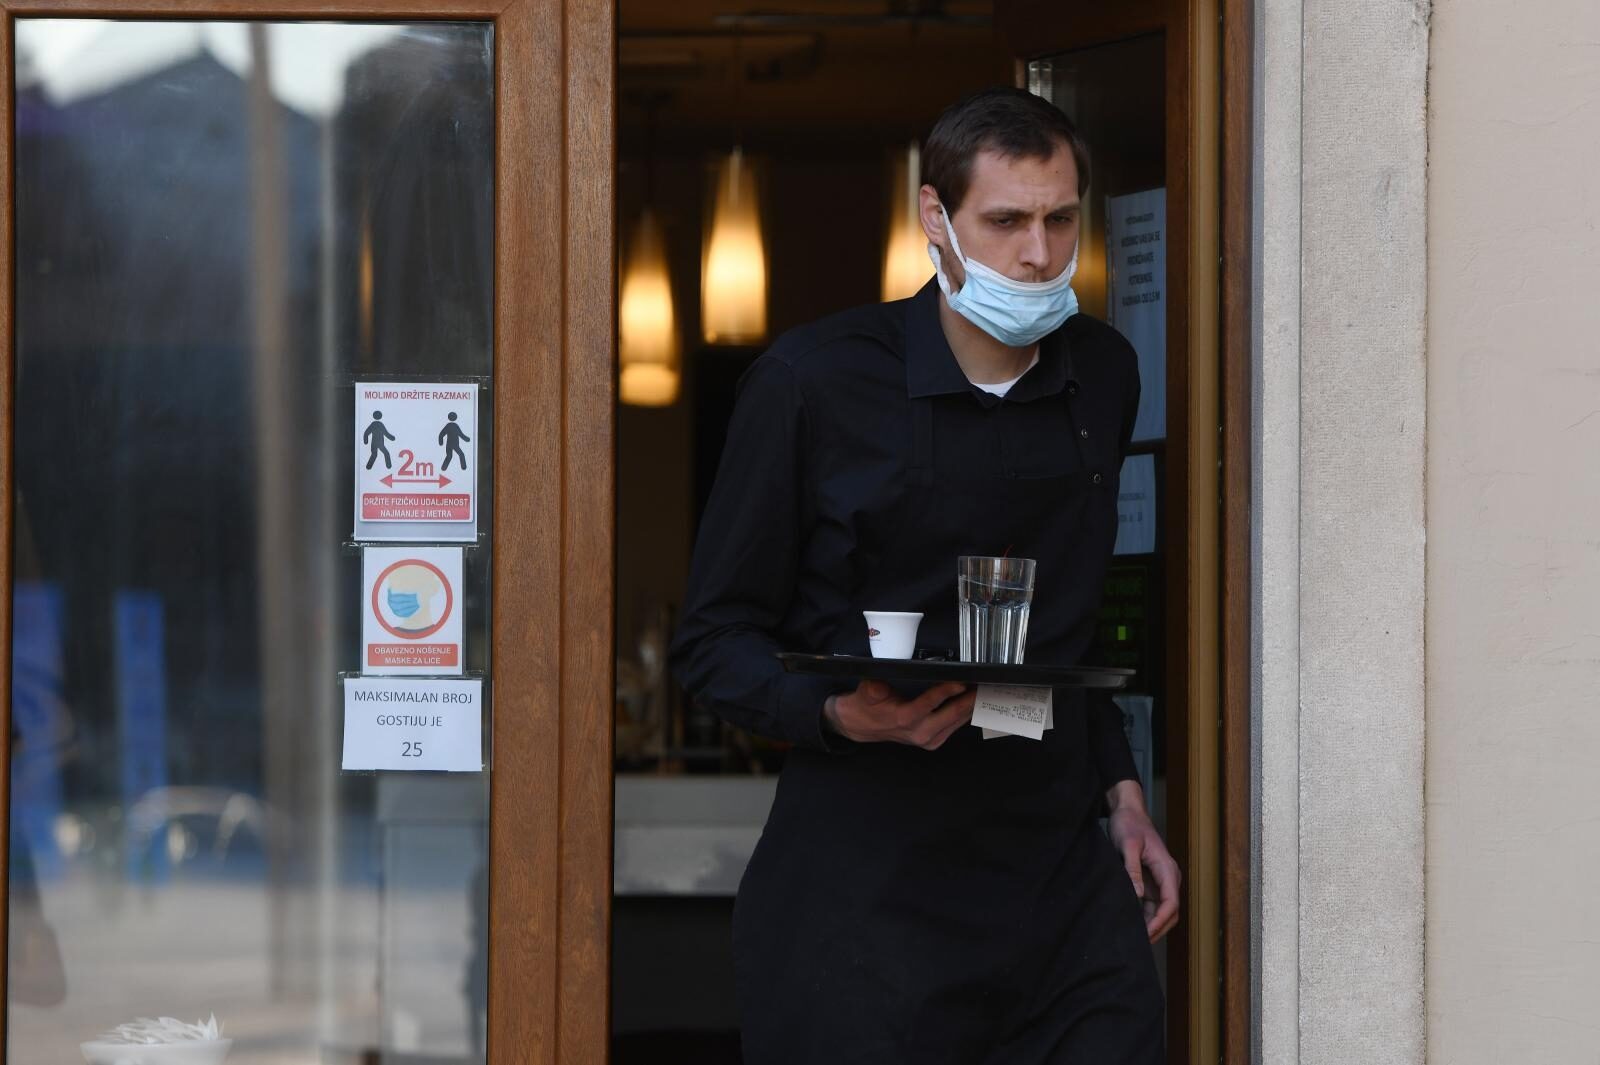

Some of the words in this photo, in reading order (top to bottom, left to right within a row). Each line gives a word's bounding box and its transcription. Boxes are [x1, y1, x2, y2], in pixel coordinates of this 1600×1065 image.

[364, 391, 399, 400] MOLIMO
[400, 390, 430, 400] DRŽITE
[432, 391, 471, 401] RAZMAK!
[397, 449, 435, 477] 2m
[363, 497, 390, 506] DRŽITE
[420, 498, 469, 507] UDALJENOST
[380, 509, 419, 518] NAJMANJE
[426, 509, 452, 518] METRA
[374, 647, 415, 655] OBAVEZNO
[416, 646, 452, 655] NOŠENJE
[384, 657, 412, 665] MASKE
[413, 657, 423, 665] ZA
[424, 657, 441, 665] LICE
[354, 690, 438, 704] MAKSIMALAN
[442, 692, 473, 704] BROJ
[376, 715, 428, 727] GOSTIJU
[430, 716, 443, 727] JE
[401, 741, 423, 757] 25
